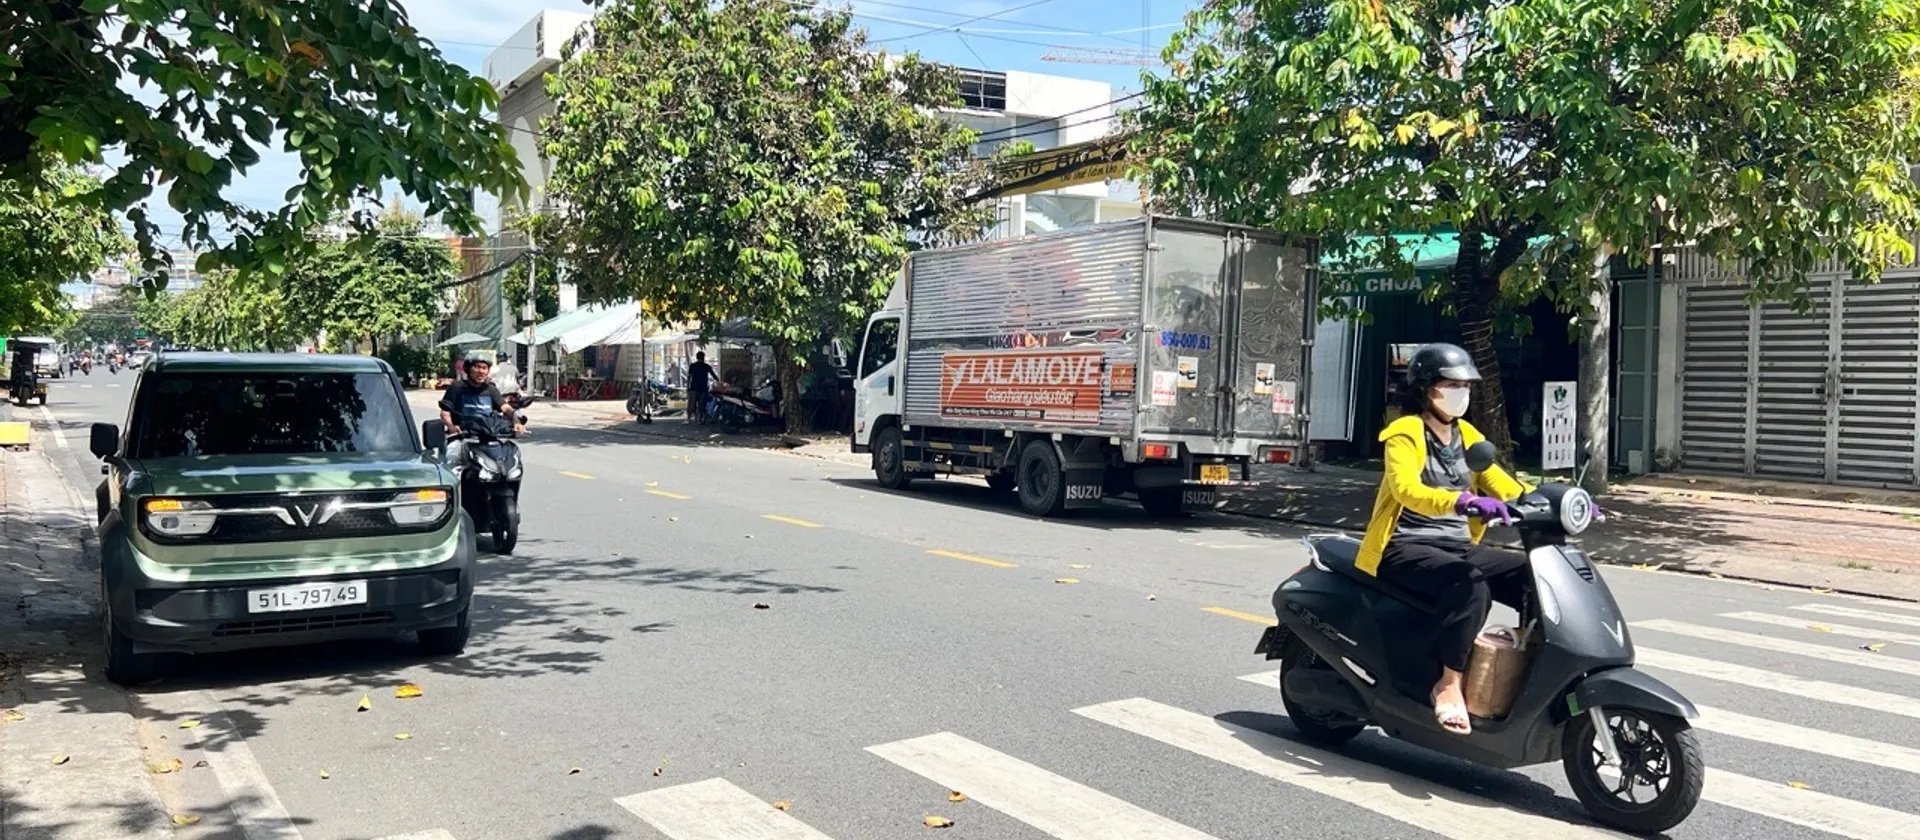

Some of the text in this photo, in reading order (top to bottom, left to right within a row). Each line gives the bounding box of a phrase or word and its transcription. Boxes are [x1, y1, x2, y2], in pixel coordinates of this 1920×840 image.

[968, 356, 1100, 385] LALAMOVE
[1066, 485, 1102, 500] ISUZU
[1182, 490, 1215, 504] ISUZU
[259, 586, 358, 608] 51L-797.49
